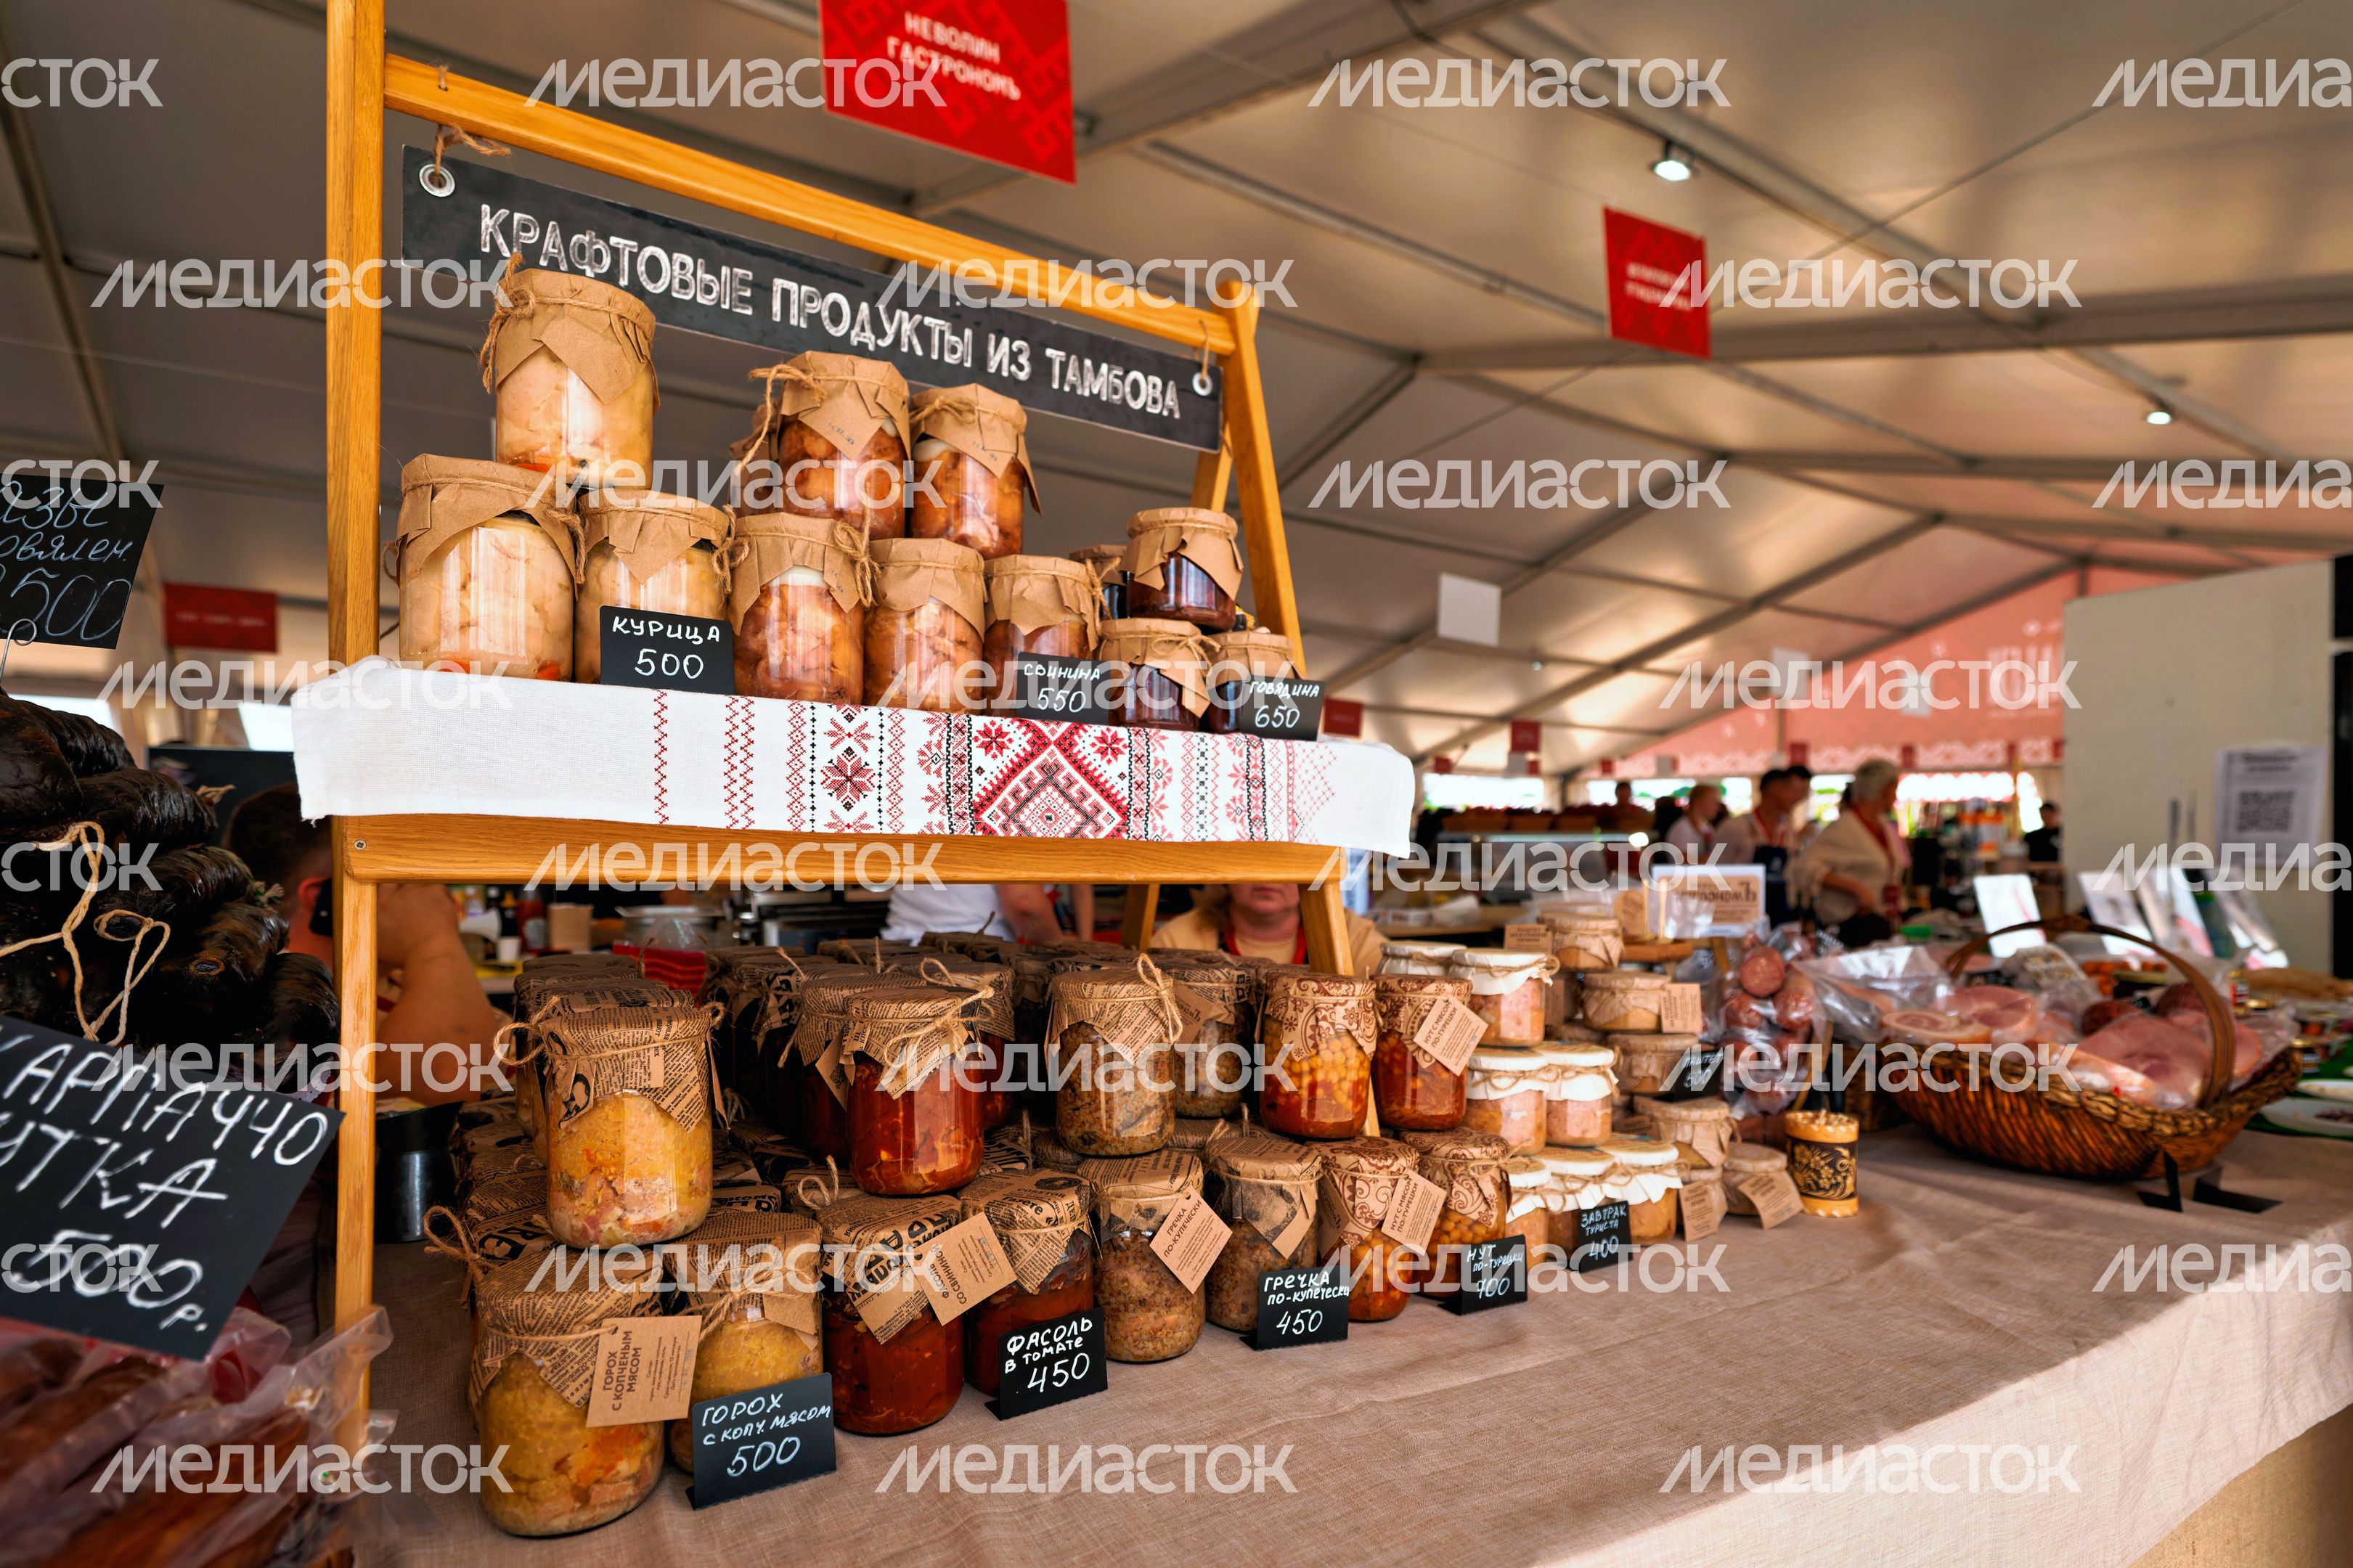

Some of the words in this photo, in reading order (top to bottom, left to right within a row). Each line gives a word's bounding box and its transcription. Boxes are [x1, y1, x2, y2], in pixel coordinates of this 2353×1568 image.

[480, 203, 754, 317] КРАФТОВЫЕ
[771, 277, 972, 368] ПРОДУКТЫ
[987, 335, 1032, 382] ИЗ
[1045, 348, 1181, 420] ТАМБОВА
[612, 616, 721, 645] КУРИЦА
[635, 648, 704, 679] 500
[1023, 662, 1101, 682] СВИНИНА
[1036, 687, 1087, 714] 550
[1249, 679, 1320, 700] ГОВЯДИНА
[1255, 704, 1302, 729] 650
[1423, 1029, 1435, 1044] НУТ
[1435, 1000, 1452, 1026] МЯСОМ
[1431, 1007, 1459, 1048] ПО-ТУРЕЦКИ
[0, 1026, 327, 1166] АРПАЧЧО
[1390, 1214, 1400, 1230] НУТ
[1398, 1177, 1413, 1208] МЯСОМ
[1397, 1183, 1420, 1233] ПО-ТУРЕЦКИ
[1581, 1205, 1626, 1228] ЗАВТРАК
[1163, 1200, 1203, 1258] ПО-КУПЕЧЕСКИ
[1166, 1207, 1187, 1236] ГРЕЧКА
[1586, 1219, 1619, 1236] ТУРИСТА
[1467, 1244, 1496, 1262] НУТ
[1589, 1236, 1619, 1260] 400
[9, 1229, 203, 1309] 500
[927, 1263, 951, 1299] ФАСОЛЬ
[931, 1244, 962, 1293] СВИНИНОЙ
[955, 1291, 968, 1304] СО
[1006, 1318, 1093, 1355] ФАСОЛЬ
[1276, 1309, 1324, 1336] 450
[603, 1351, 617, 1391] ГОРОХ
[613, 1331, 632, 1400] КОПЧЕНЫМ
[627, 1347, 641, 1392] МЯСОМ
[1005, 1359, 1016, 1374] В
[1027, 1352, 1090, 1394] 450
[612, 1402, 621, 1411] С
[702, 1393, 784, 1426] ГОРОХ
[770, 1405, 831, 1431] МЯСОМ
[726, 1437, 801, 1477] 500
